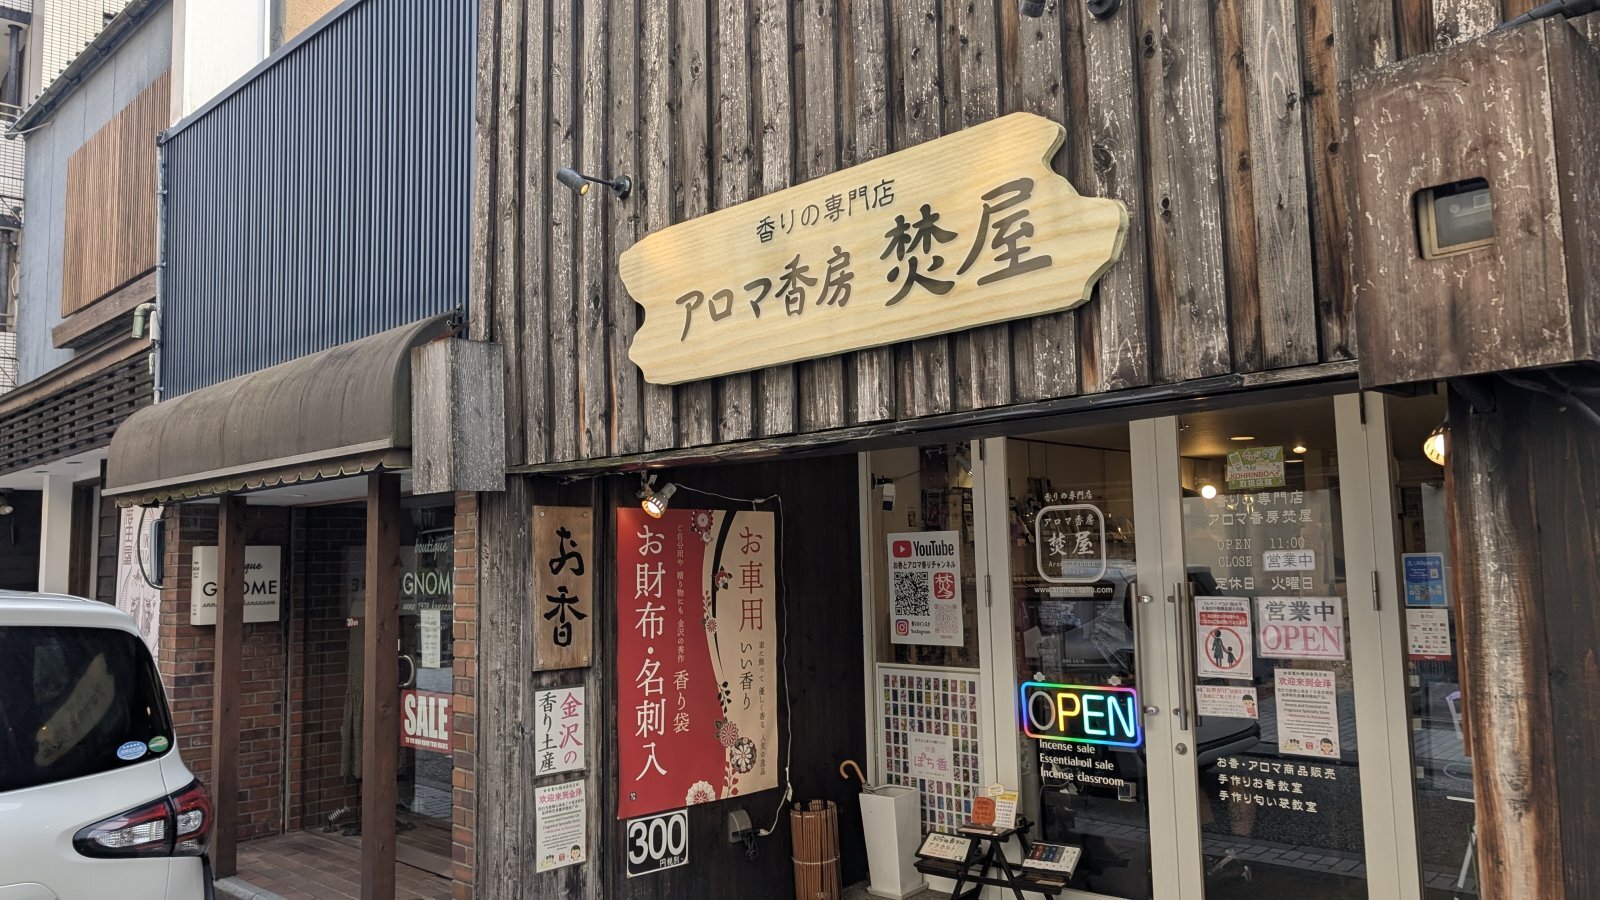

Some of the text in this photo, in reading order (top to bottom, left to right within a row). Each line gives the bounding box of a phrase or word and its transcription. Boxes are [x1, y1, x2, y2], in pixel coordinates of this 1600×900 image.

[756, 179, 896, 243] 香りの専門店
[675, 177, 1052, 342] アロマ香房 焚屋
[1043, 490, 1093, 503] 香りの専門店
[1044, 514, 1095, 527] アロマ香房
[1208, 508, 1313, 526] アロマ香房焚屋
[414, 538, 449, 560] boutique
[913, 539, 955, 557] YouTube
[1047, 530, 1095, 556] 焚屋
[1217, 536, 1305, 550] OPEN 11:00
[1218, 552, 1312, 569] CLOSE 営業中
[402, 571, 455, 595] GNOM
[543, 526, 588, 647] お香
[739, 526, 764, 632] お車用
[1215, 576, 1313, 590] 定休日 火曜日
[1265, 600, 1335, 622] 営業中
[1262, 624, 1342, 652] OPEN
[634, 525, 668, 781] お財布・名刺入
[739, 642, 754, 710] いい香り
[673, 669, 690, 734] 香り袋
[404, 693, 448, 740] SALE
[1028, 691, 1136, 738] OPEN
[538, 691, 558, 773] 香り土産
[559, 691, 584, 764] 金沢の
[1040, 738, 1096, 754] Incense sale
[1040, 753, 1114, 771] Essential oil sale
[1216, 757, 1336, 780] お香・アロマ商品販売
[1041, 768, 1125, 787] Incense classroom
[1218, 774, 1303, 794] 手作りお香教室
[1219, 790, 1318, 813] 手作り匂い袋教室
[628, 813, 686, 865] 300
